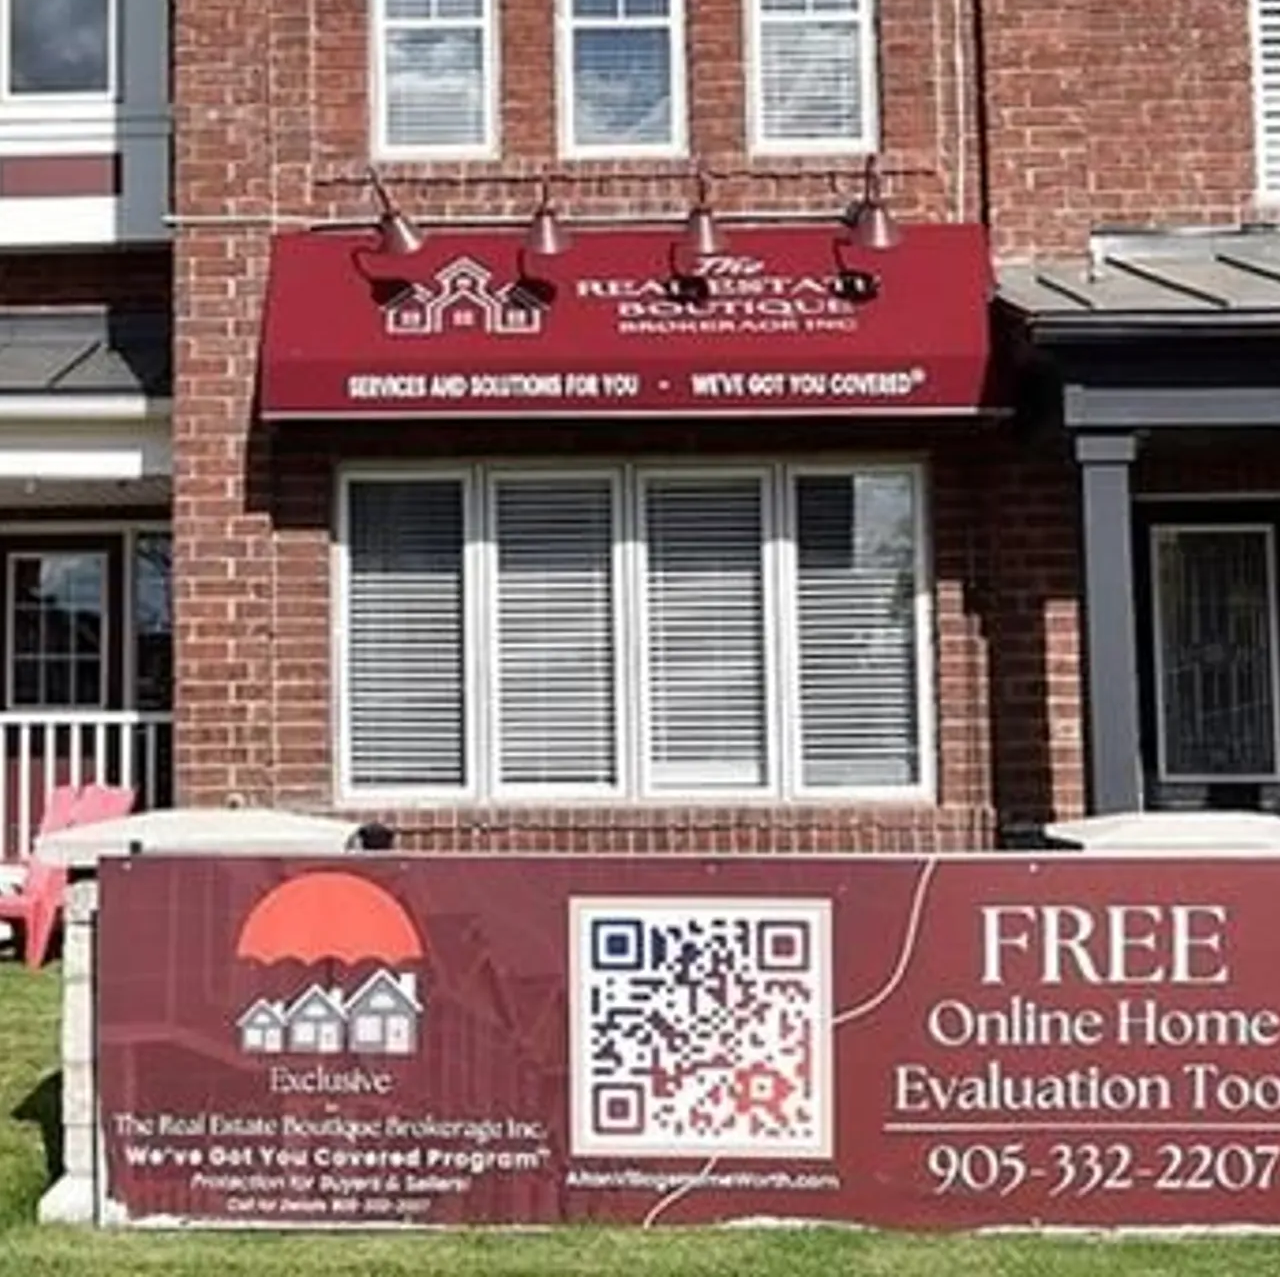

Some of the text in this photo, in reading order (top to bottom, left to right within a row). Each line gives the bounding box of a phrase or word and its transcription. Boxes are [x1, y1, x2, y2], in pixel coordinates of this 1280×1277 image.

[619, 297, 856, 316] BOUTIQUE
[348, 374, 426, 397] SERVICES
[430, 374, 468, 397] AND
[471, 374, 561, 397] SOLUTIONS
[565, 374, 599, 396] FOR
[602, 374, 639, 396] YOU
[748, 373, 784, 395] GOT
[790, 373, 826, 394] YOU
[980, 904, 1229, 984] FREE
[928, 996, 1104, 1046] Online
[270, 1066, 392, 1094] Exclusive
[894, 1061, 1170, 1111] Evaluation
[114, 1114, 153, 1135] The
[160, 1114, 206, 1135] Real
[209, 1114, 277, 1135] Estate
[282, 1114, 381, 1143] Boutique
[385, 1116, 503, 1143] Brokerage
[209, 1146, 252, 1165] Got
[258, 1146, 307, 1165] You
[314, 1148, 420, 1167] Covered
